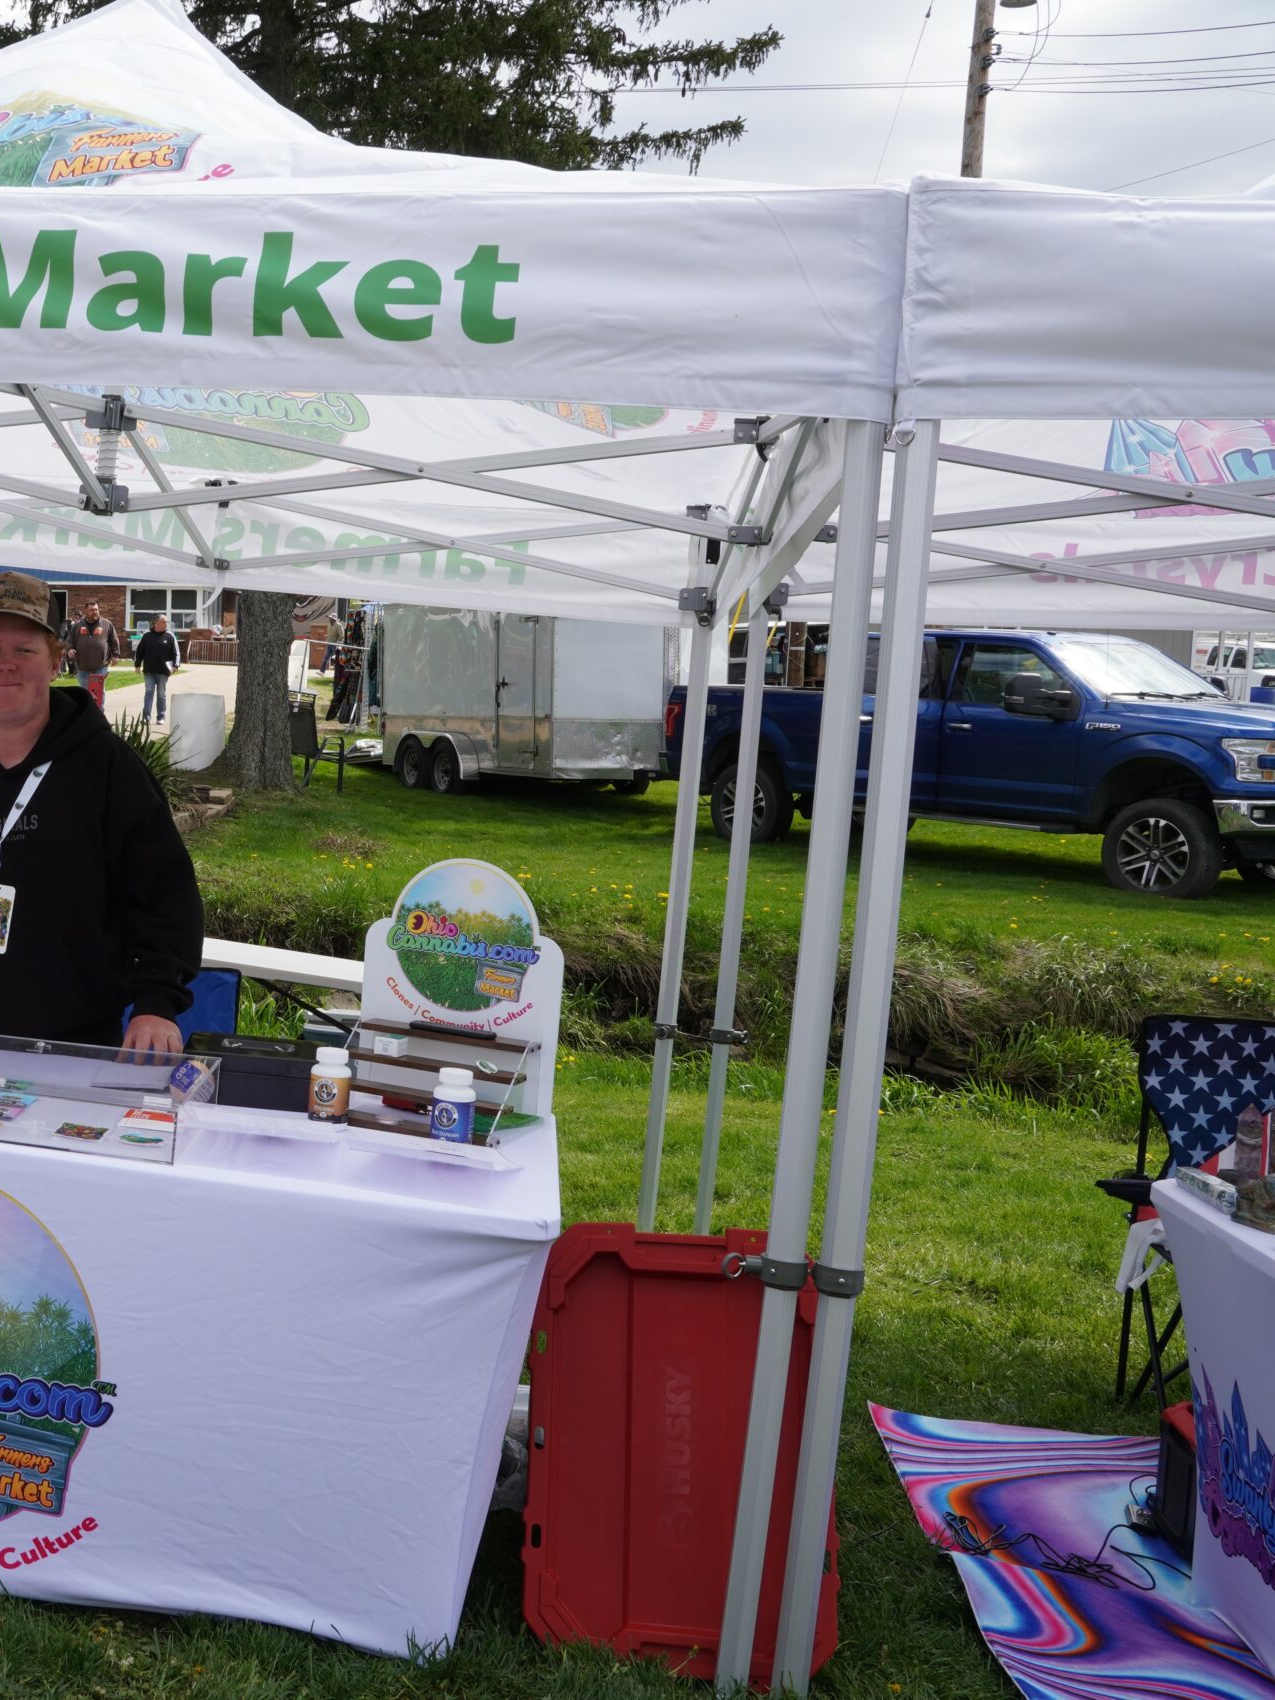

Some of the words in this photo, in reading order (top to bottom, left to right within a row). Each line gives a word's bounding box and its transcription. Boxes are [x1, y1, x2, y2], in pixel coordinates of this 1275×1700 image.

[47, 145, 177, 184] Market
[406, 909, 459, 937] Ohio
[386, 923, 540, 965] Cannabis.com
[478, 981, 517, 999] Market
[483, 967, 517, 985] Farmers
[386, 976, 414, 1010] Clones
[493, 1001, 534, 1027] Culture
[664, 1364, 694, 1495] HUSKY
